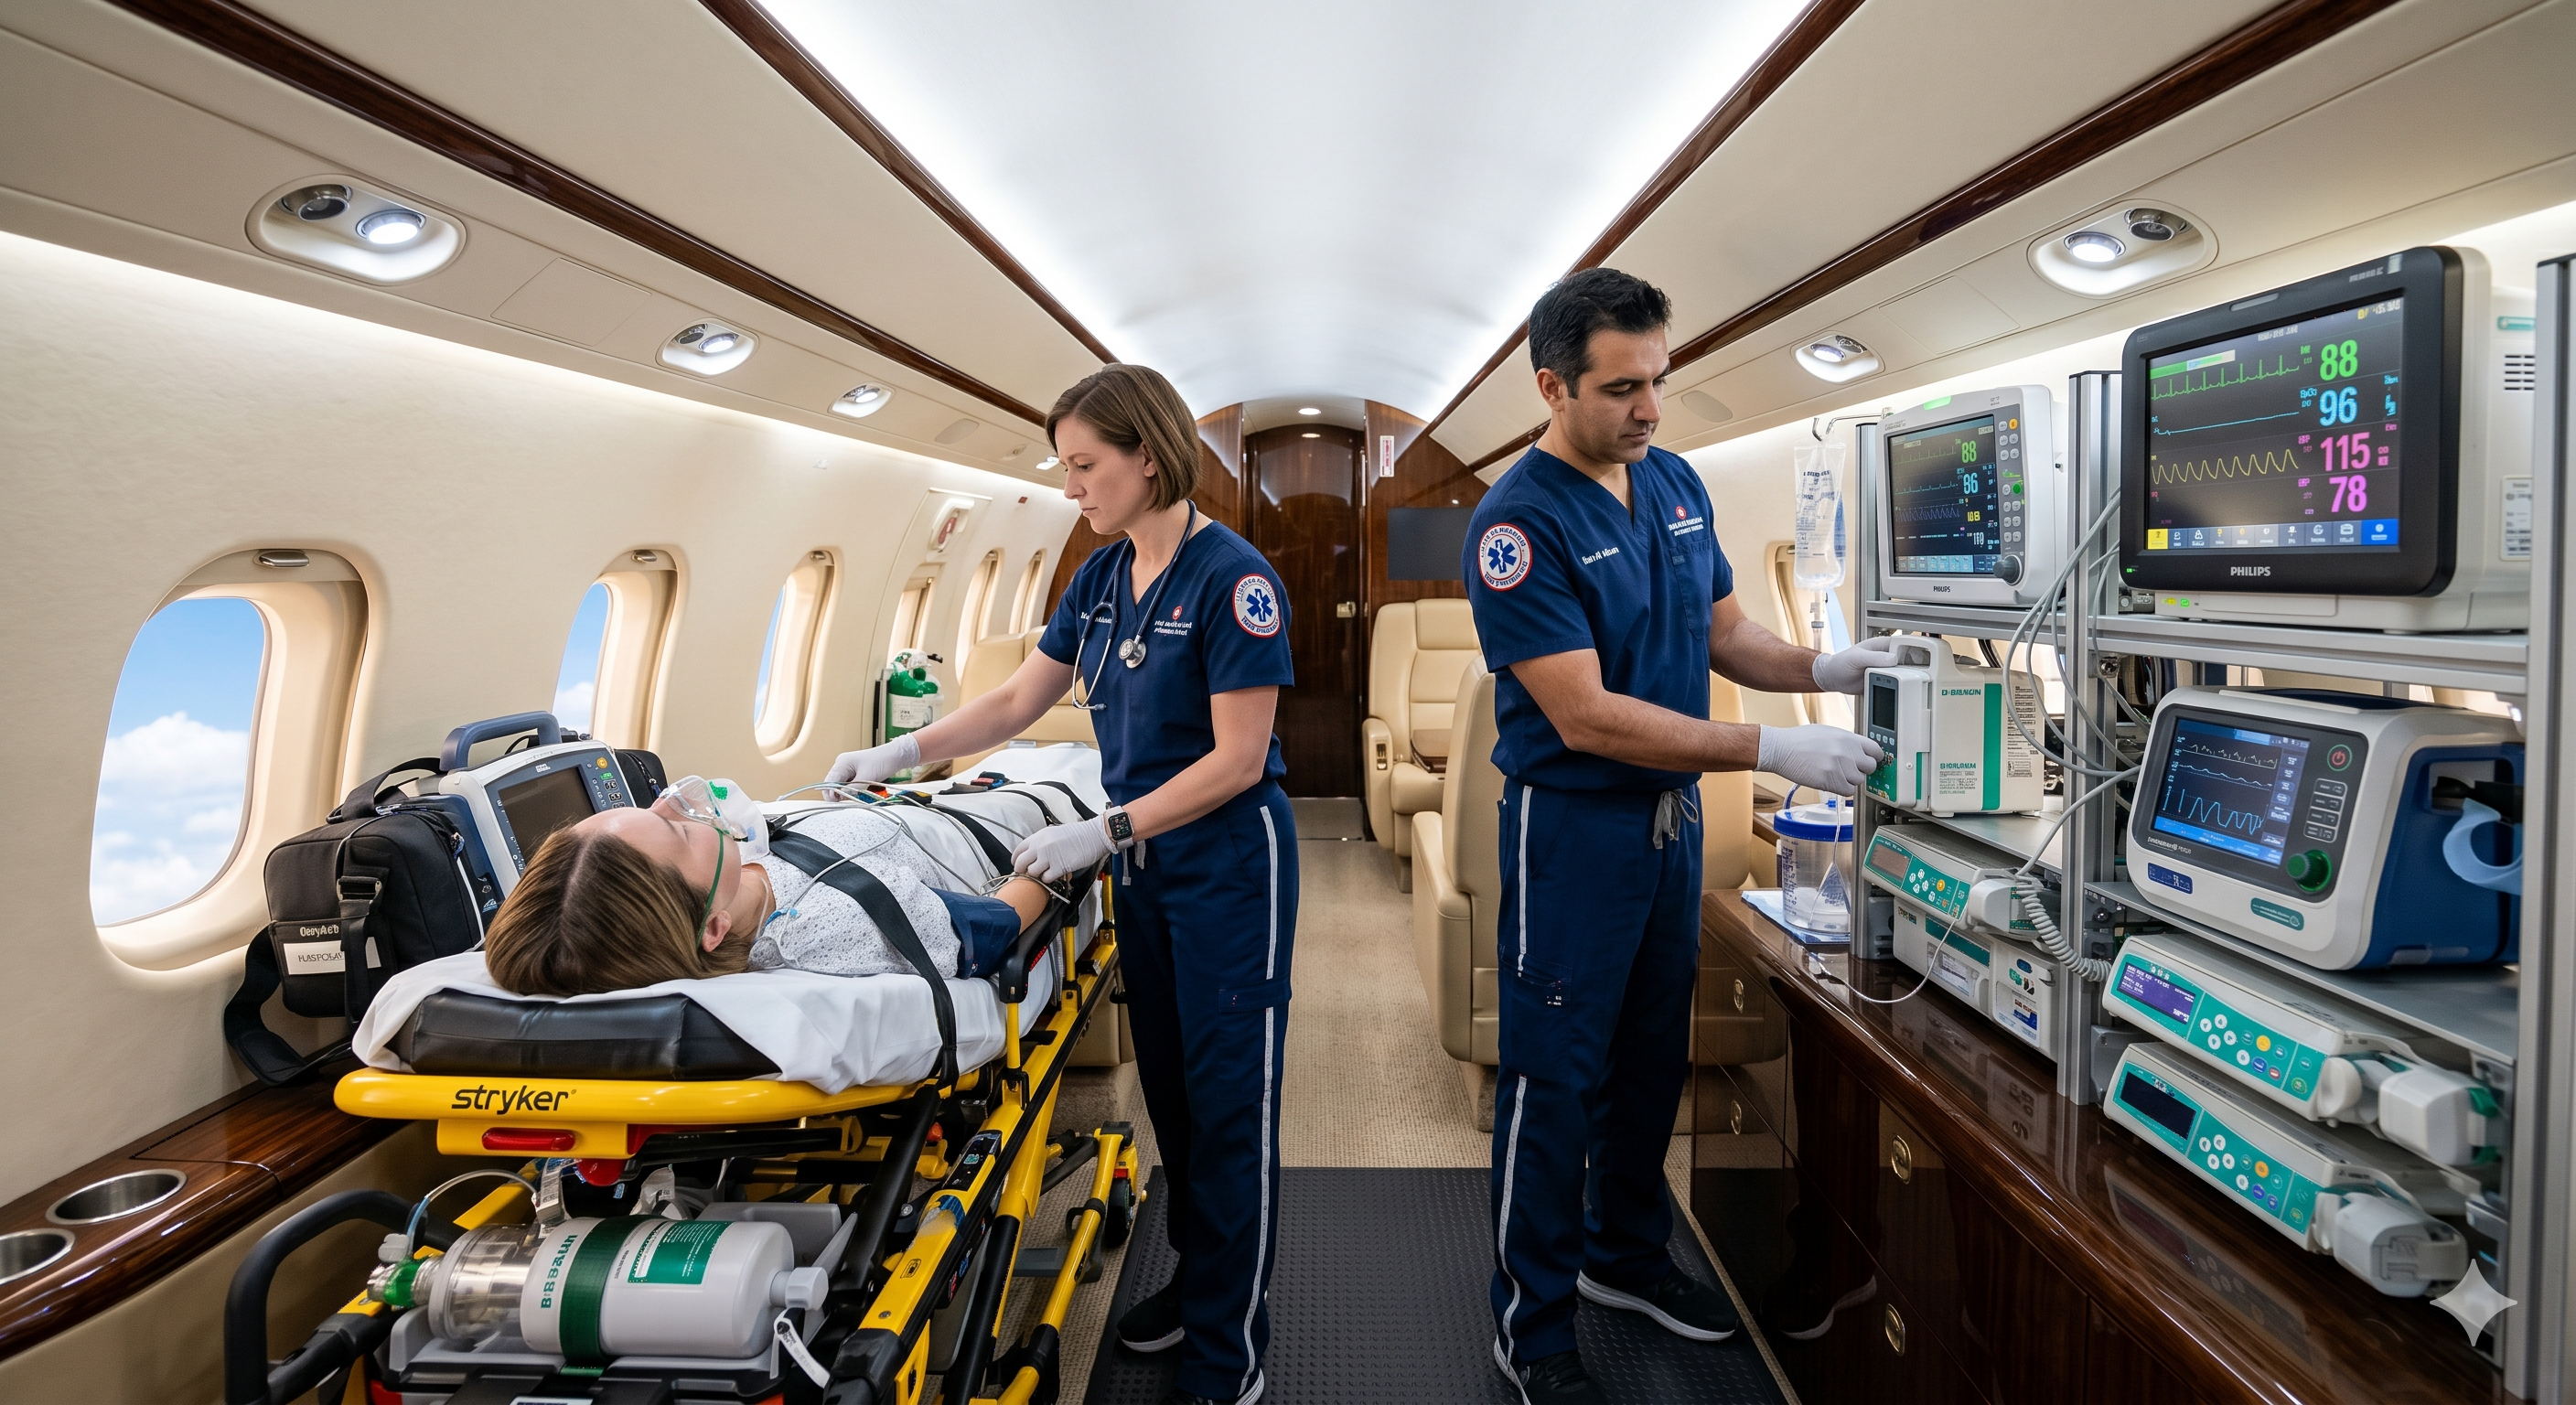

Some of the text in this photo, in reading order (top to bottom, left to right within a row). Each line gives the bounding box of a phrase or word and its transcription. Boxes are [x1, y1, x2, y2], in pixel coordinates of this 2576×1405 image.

[2320, 339, 2358, 381] 88
[2319, 386, 2357, 426] 96
[2320, 432, 2371, 472] 115
[2328, 475, 2367, 512] 78
[2230, 566, 2271, 576] PHILIPS
[451, 1084, 569, 1115] stryker
